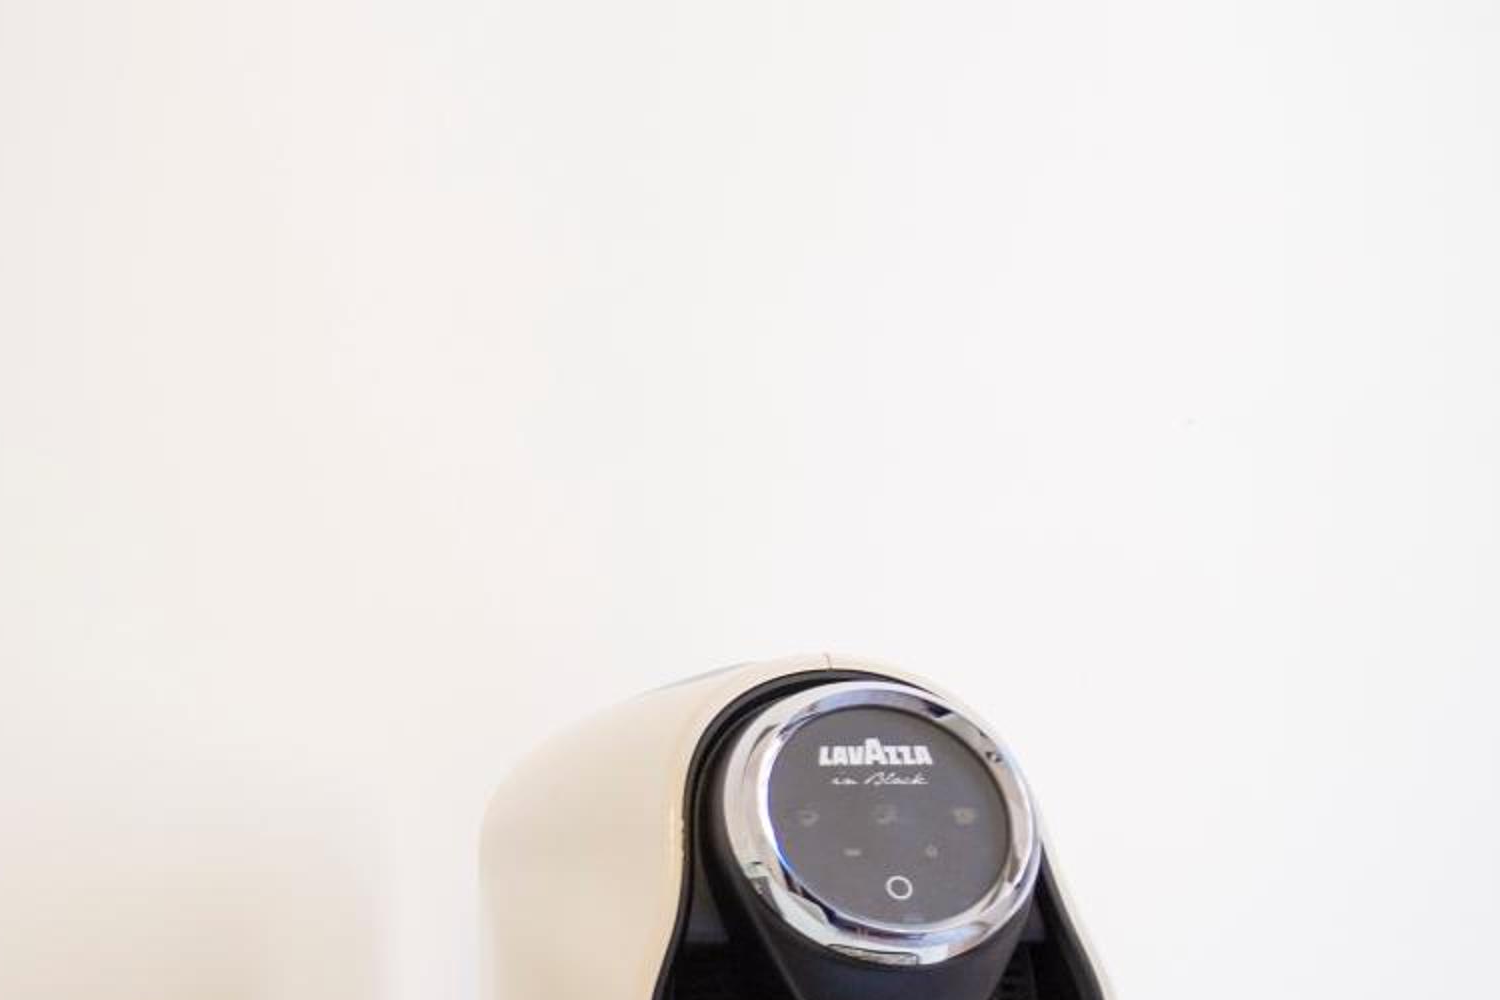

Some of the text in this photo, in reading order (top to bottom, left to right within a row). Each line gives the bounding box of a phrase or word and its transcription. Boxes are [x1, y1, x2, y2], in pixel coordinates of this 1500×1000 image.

[818, 737, 933, 767] LAVAZZA
[830, 770, 930, 787] in Black
